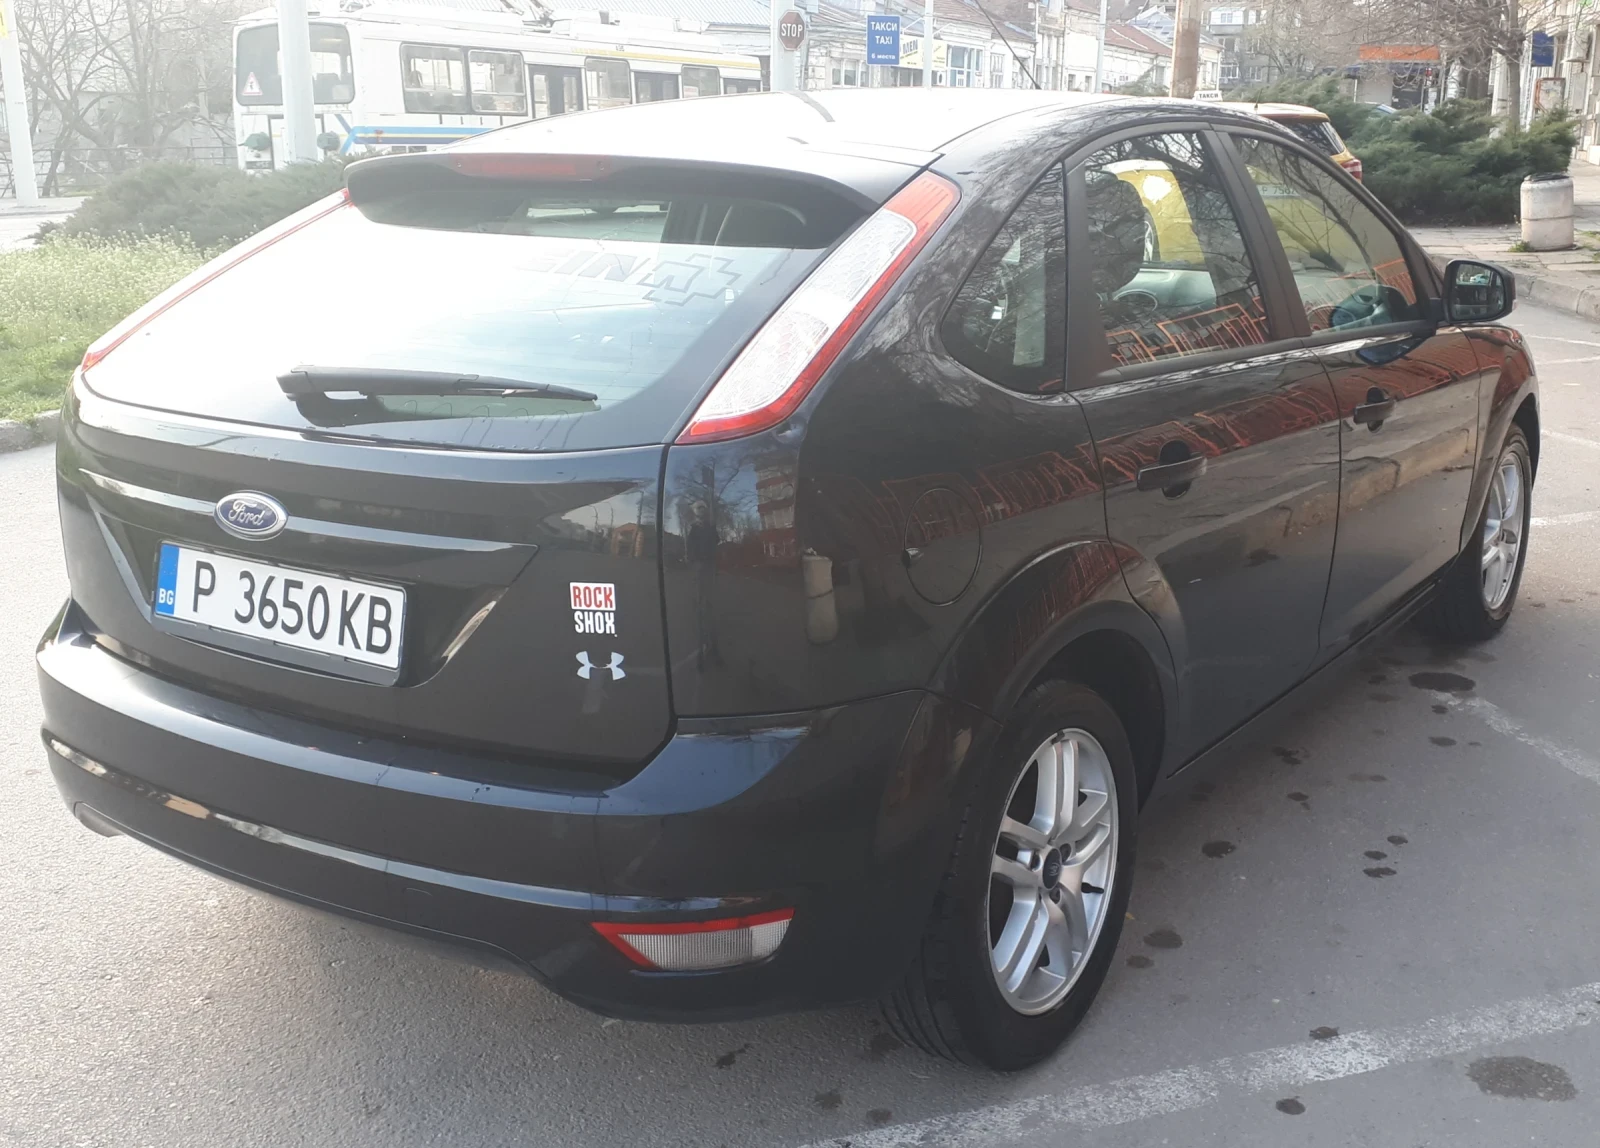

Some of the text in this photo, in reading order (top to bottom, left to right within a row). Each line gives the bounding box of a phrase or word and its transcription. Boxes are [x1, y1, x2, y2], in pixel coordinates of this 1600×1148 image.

[781, 23, 803, 38] STOP
[870, 21, 898, 31] ТАКСИ
[875, 35, 893, 45] TAXI
[228, 499, 266, 526] Ford
[158, 587, 174, 605] BG
[192, 560, 216, 613] P
[572, 585, 613, 608] ROCK
[574, 610, 616, 634] SHOX
